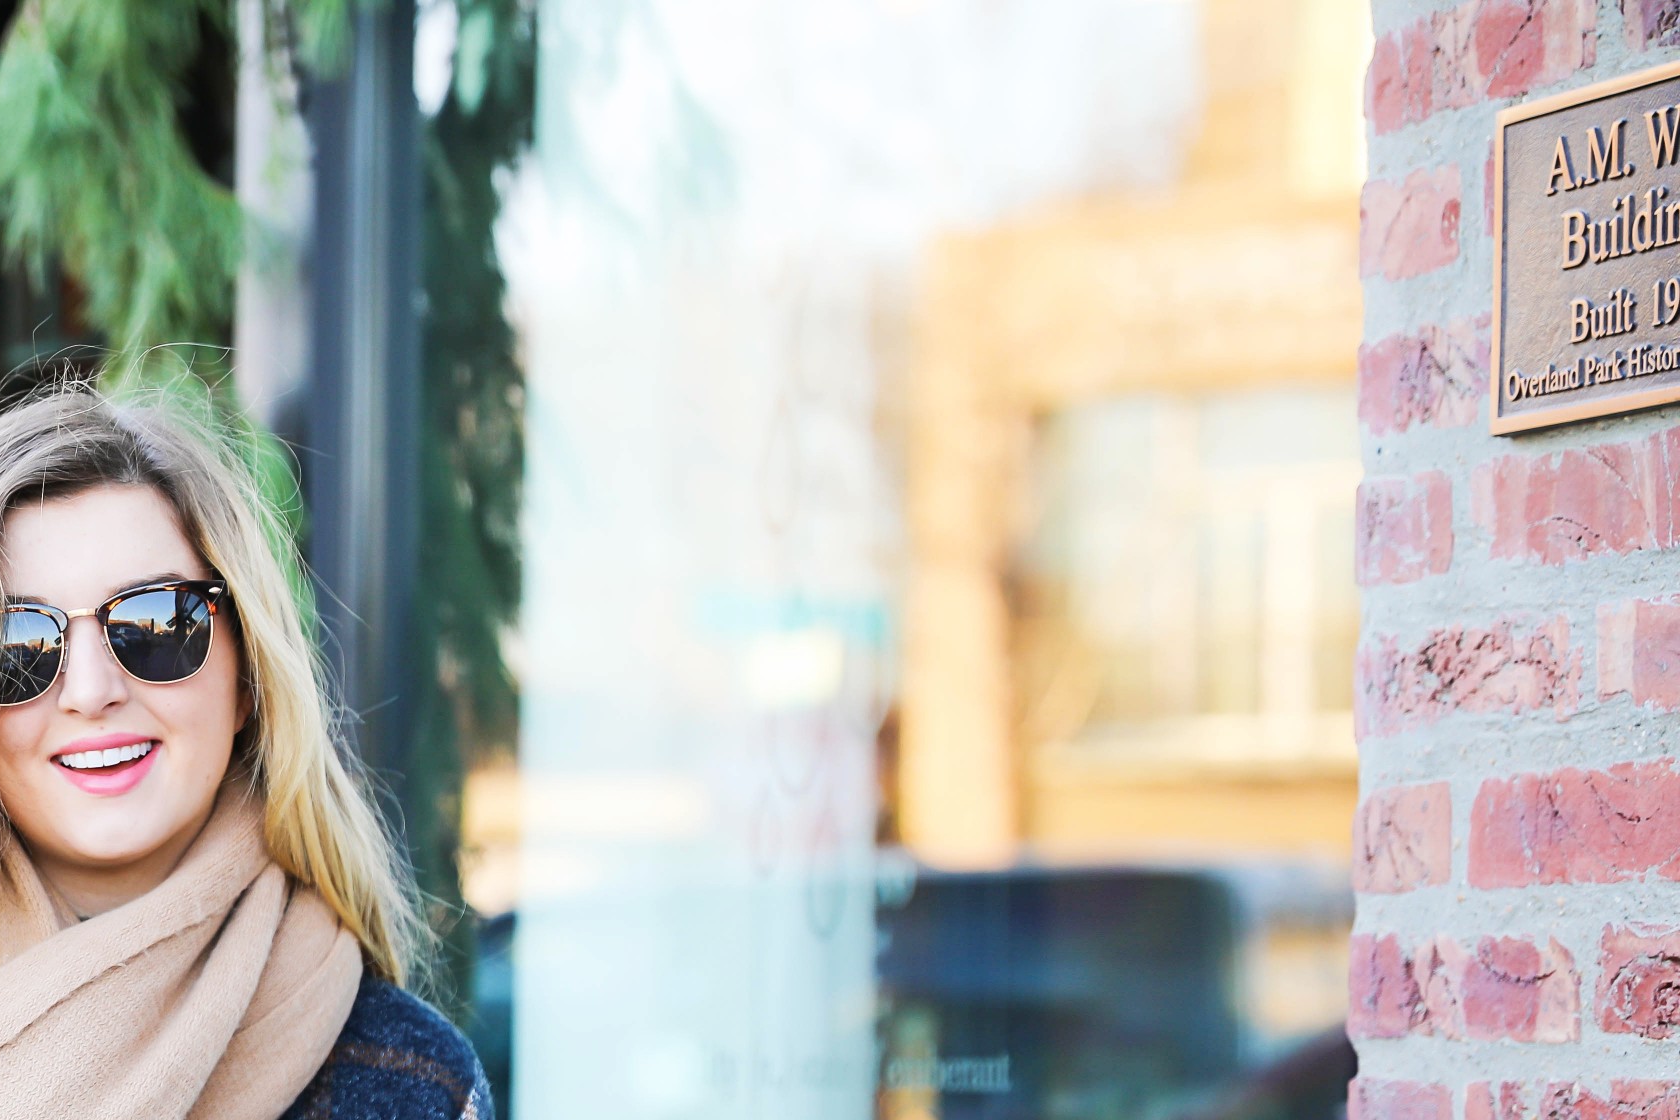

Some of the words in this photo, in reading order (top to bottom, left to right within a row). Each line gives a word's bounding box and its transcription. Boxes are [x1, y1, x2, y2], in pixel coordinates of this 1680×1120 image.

[1545, 117, 1634, 196] A.M.
[1570, 287, 1637, 344] Built
[1652, 276, 1680, 327] 19
[1505, 360, 1584, 402] Overland
[1584, 350, 1627, 387] Park
